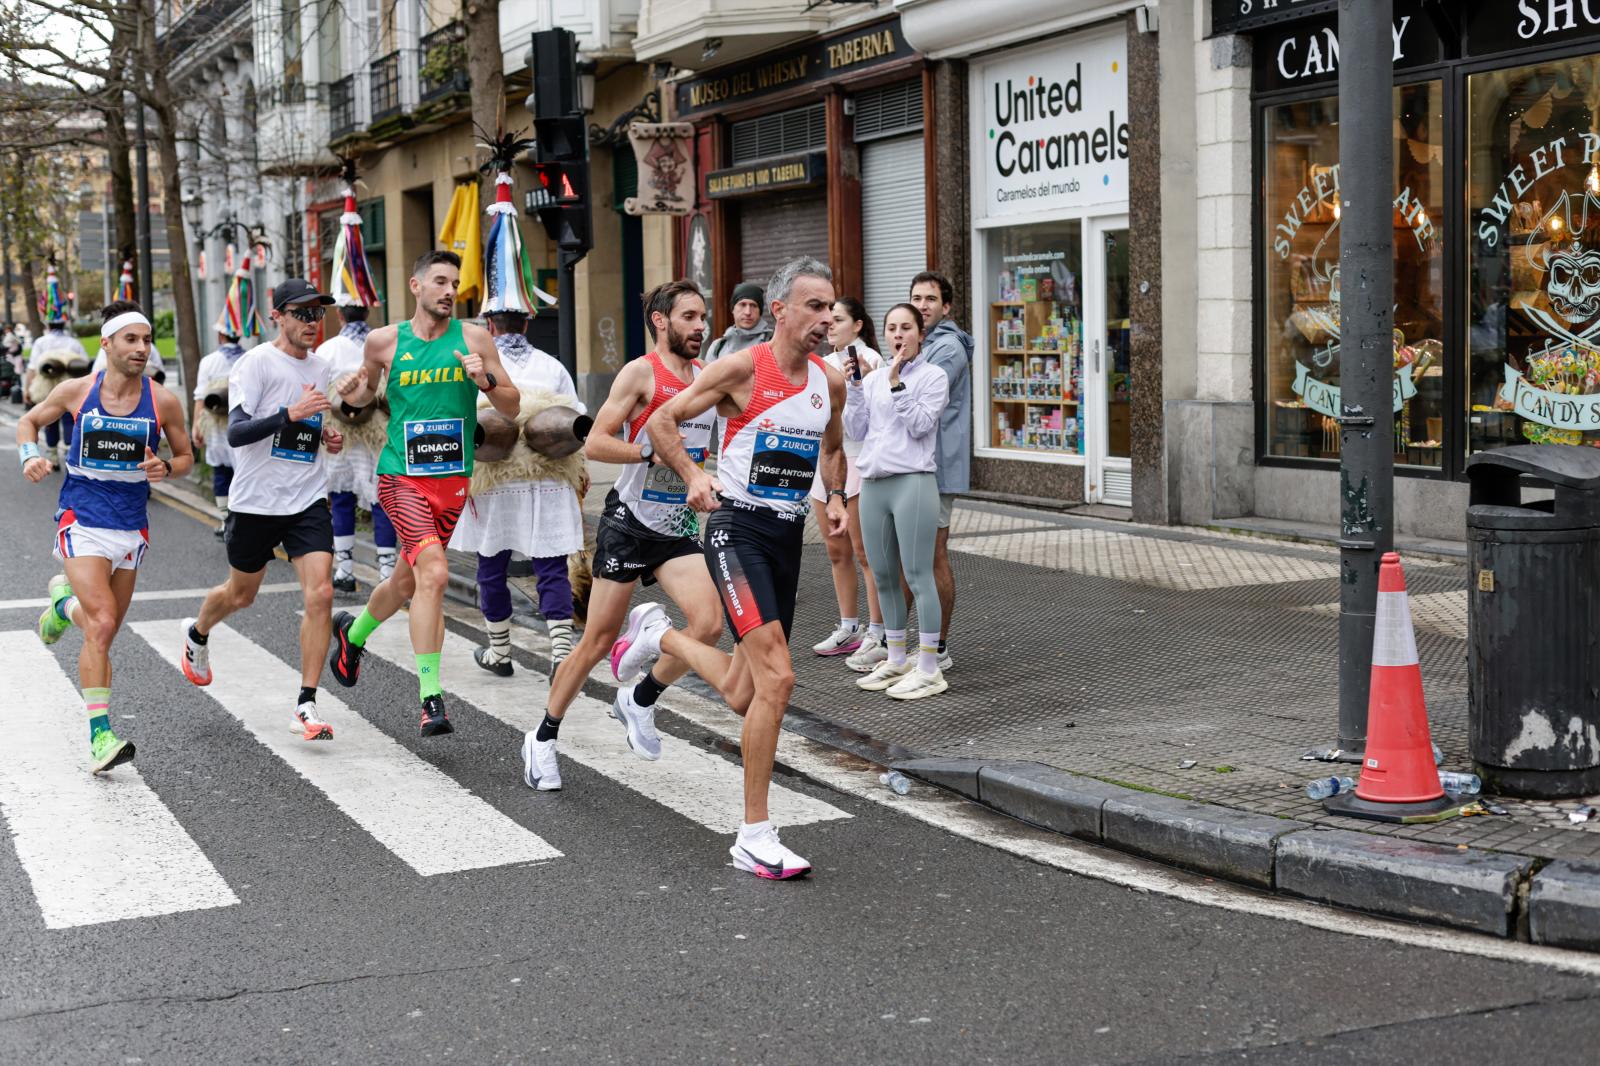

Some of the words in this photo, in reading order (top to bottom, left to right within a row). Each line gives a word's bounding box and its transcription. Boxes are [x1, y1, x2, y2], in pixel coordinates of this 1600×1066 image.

[1277, 16, 1411, 79] CANY
[690, 81, 729, 107] MUSEO
[732, 71, 754, 96] DEL
[757, 55, 808, 88] WHISKY
[828, 30, 896, 69] TABERNA
[995, 62, 1082, 127] United
[996, 110, 1129, 178] Caramels
[772, 163, 805, 183] TABERNA
[997, 184, 1037, 203] Caramelos
[1038, 180, 1050, 197] del
[1051, 177, 1081, 196] mundo
[1479, 137, 1567, 248] SWEET
[1274, 163, 1341, 260] SWEET
[1393, 186, 1435, 252] ATE
[400, 367, 464, 387] BIKILA
[1308, 384, 1341, 415] CAN
[1519, 391, 1586, 426] CANDY
[106, 421, 138, 431] ZURICH
[427, 423, 455, 432] ZURICH
[679, 420, 695, 430] uper
[780, 425, 805, 437] super
[296, 432, 312, 442] AKI
[97, 440, 136, 452] SIMON
[296, 443, 306, 451] 36
[416, 442, 459, 453] IGNACIO
[782, 439, 814, 452] ZURICH
[433, 455, 444, 463] 25
[758, 464, 780, 475] JOSE
[780, 467, 814, 479] ANTONIO
[667, 485, 686, 494] 6998
[778, 478, 790, 488] 23
[777, 511, 798, 523] BAT
[718, 551, 732, 582] super
[726, 582, 744, 617] amara
